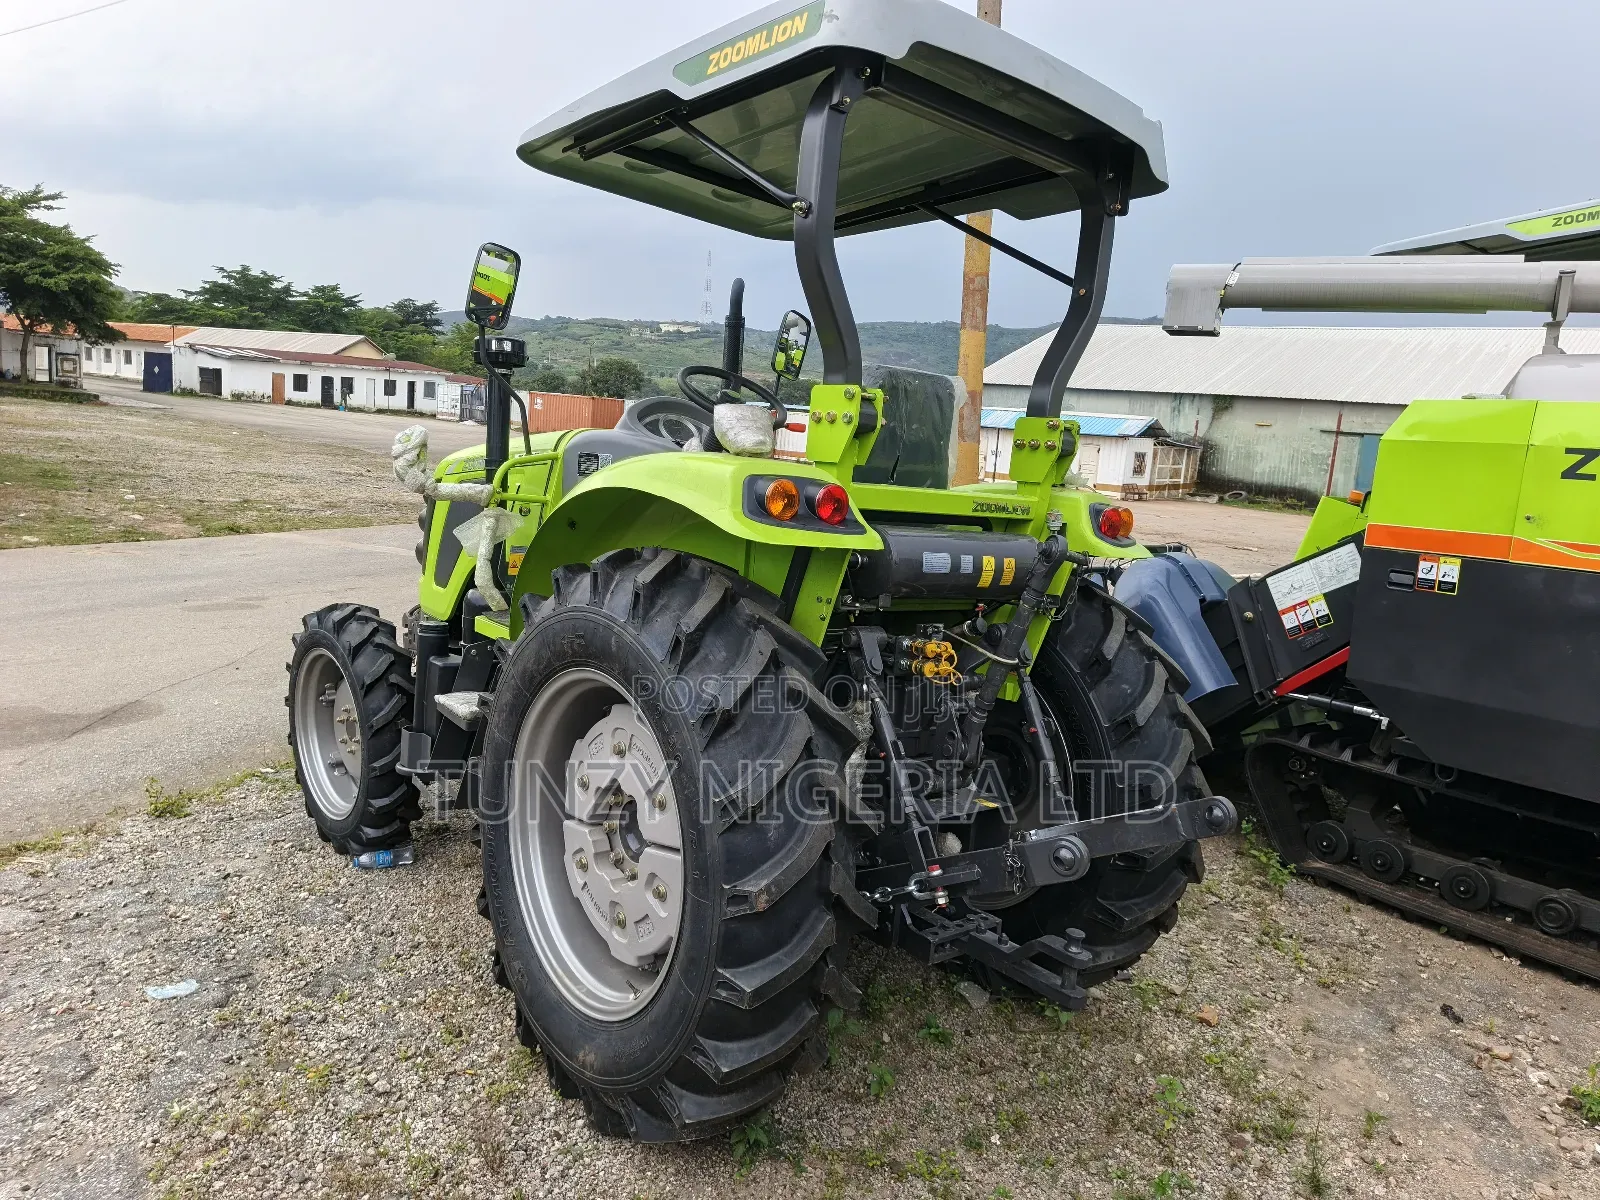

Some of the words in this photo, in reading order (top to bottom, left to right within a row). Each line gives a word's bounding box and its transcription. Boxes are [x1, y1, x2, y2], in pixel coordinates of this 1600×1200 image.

[706, 12, 809, 76] ZOOMLION
[1552, 210, 1600, 227] ZOOM
[1560, 447, 1600, 481] Z
